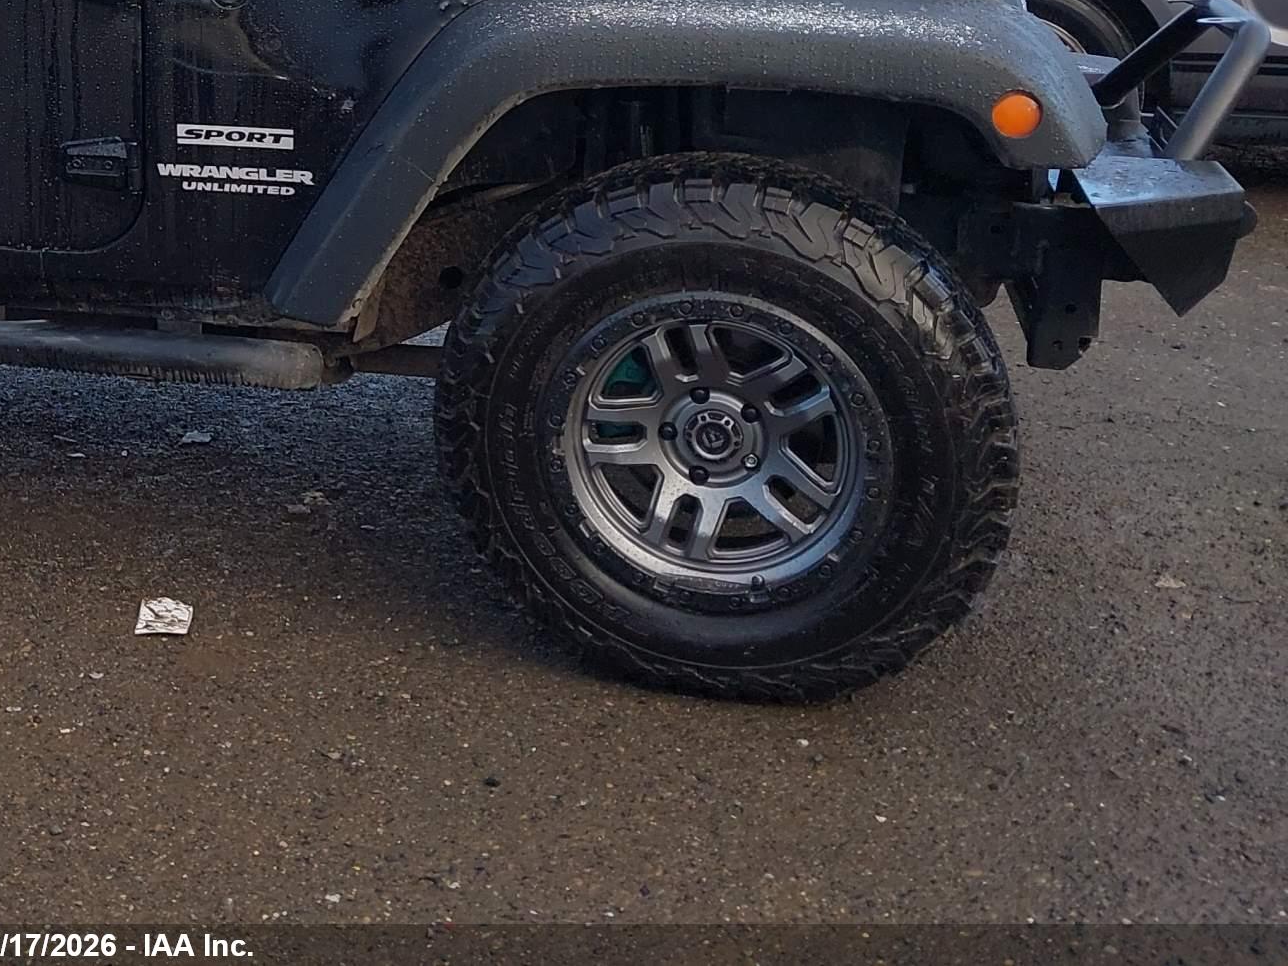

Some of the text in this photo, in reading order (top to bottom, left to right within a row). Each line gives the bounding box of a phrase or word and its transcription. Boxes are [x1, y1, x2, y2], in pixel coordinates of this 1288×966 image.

[182, 127, 287, 146] SPORT
[157, 163, 315, 185] WRANGLER
[183, 181, 296, 196] UNLIMITED
